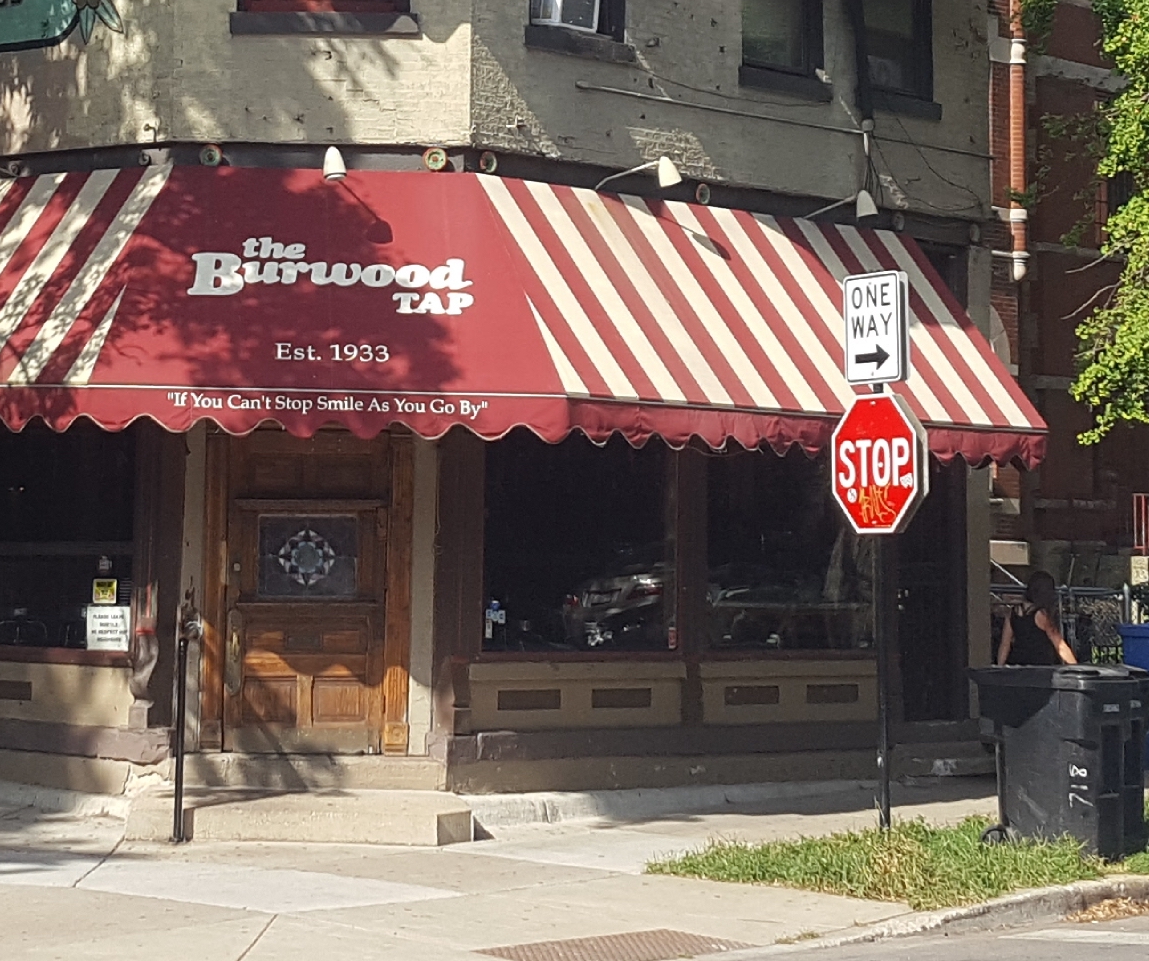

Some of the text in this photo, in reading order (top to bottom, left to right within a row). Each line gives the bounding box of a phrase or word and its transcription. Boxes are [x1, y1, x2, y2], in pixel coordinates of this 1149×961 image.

[241, 237, 306, 260] the
[187, 252, 474, 296] Burwood
[392, 292, 474, 315] TAP
[851, 283, 891, 309] ONE
[851, 312, 893, 339] WAY
[275, 343, 390, 362] Est. 1933
[191, 393, 223, 409] You
[227, 394, 271, 410] Can't
[275, 396, 313, 414] Stop
[317, 396, 364, 412] Smile
[367, 398, 390, 413] As
[396, 398, 427, 414] You
[430, 399, 454, 414] Go
[838, 437, 910, 488] STOP
[1068, 763, 1094, 808] 718
